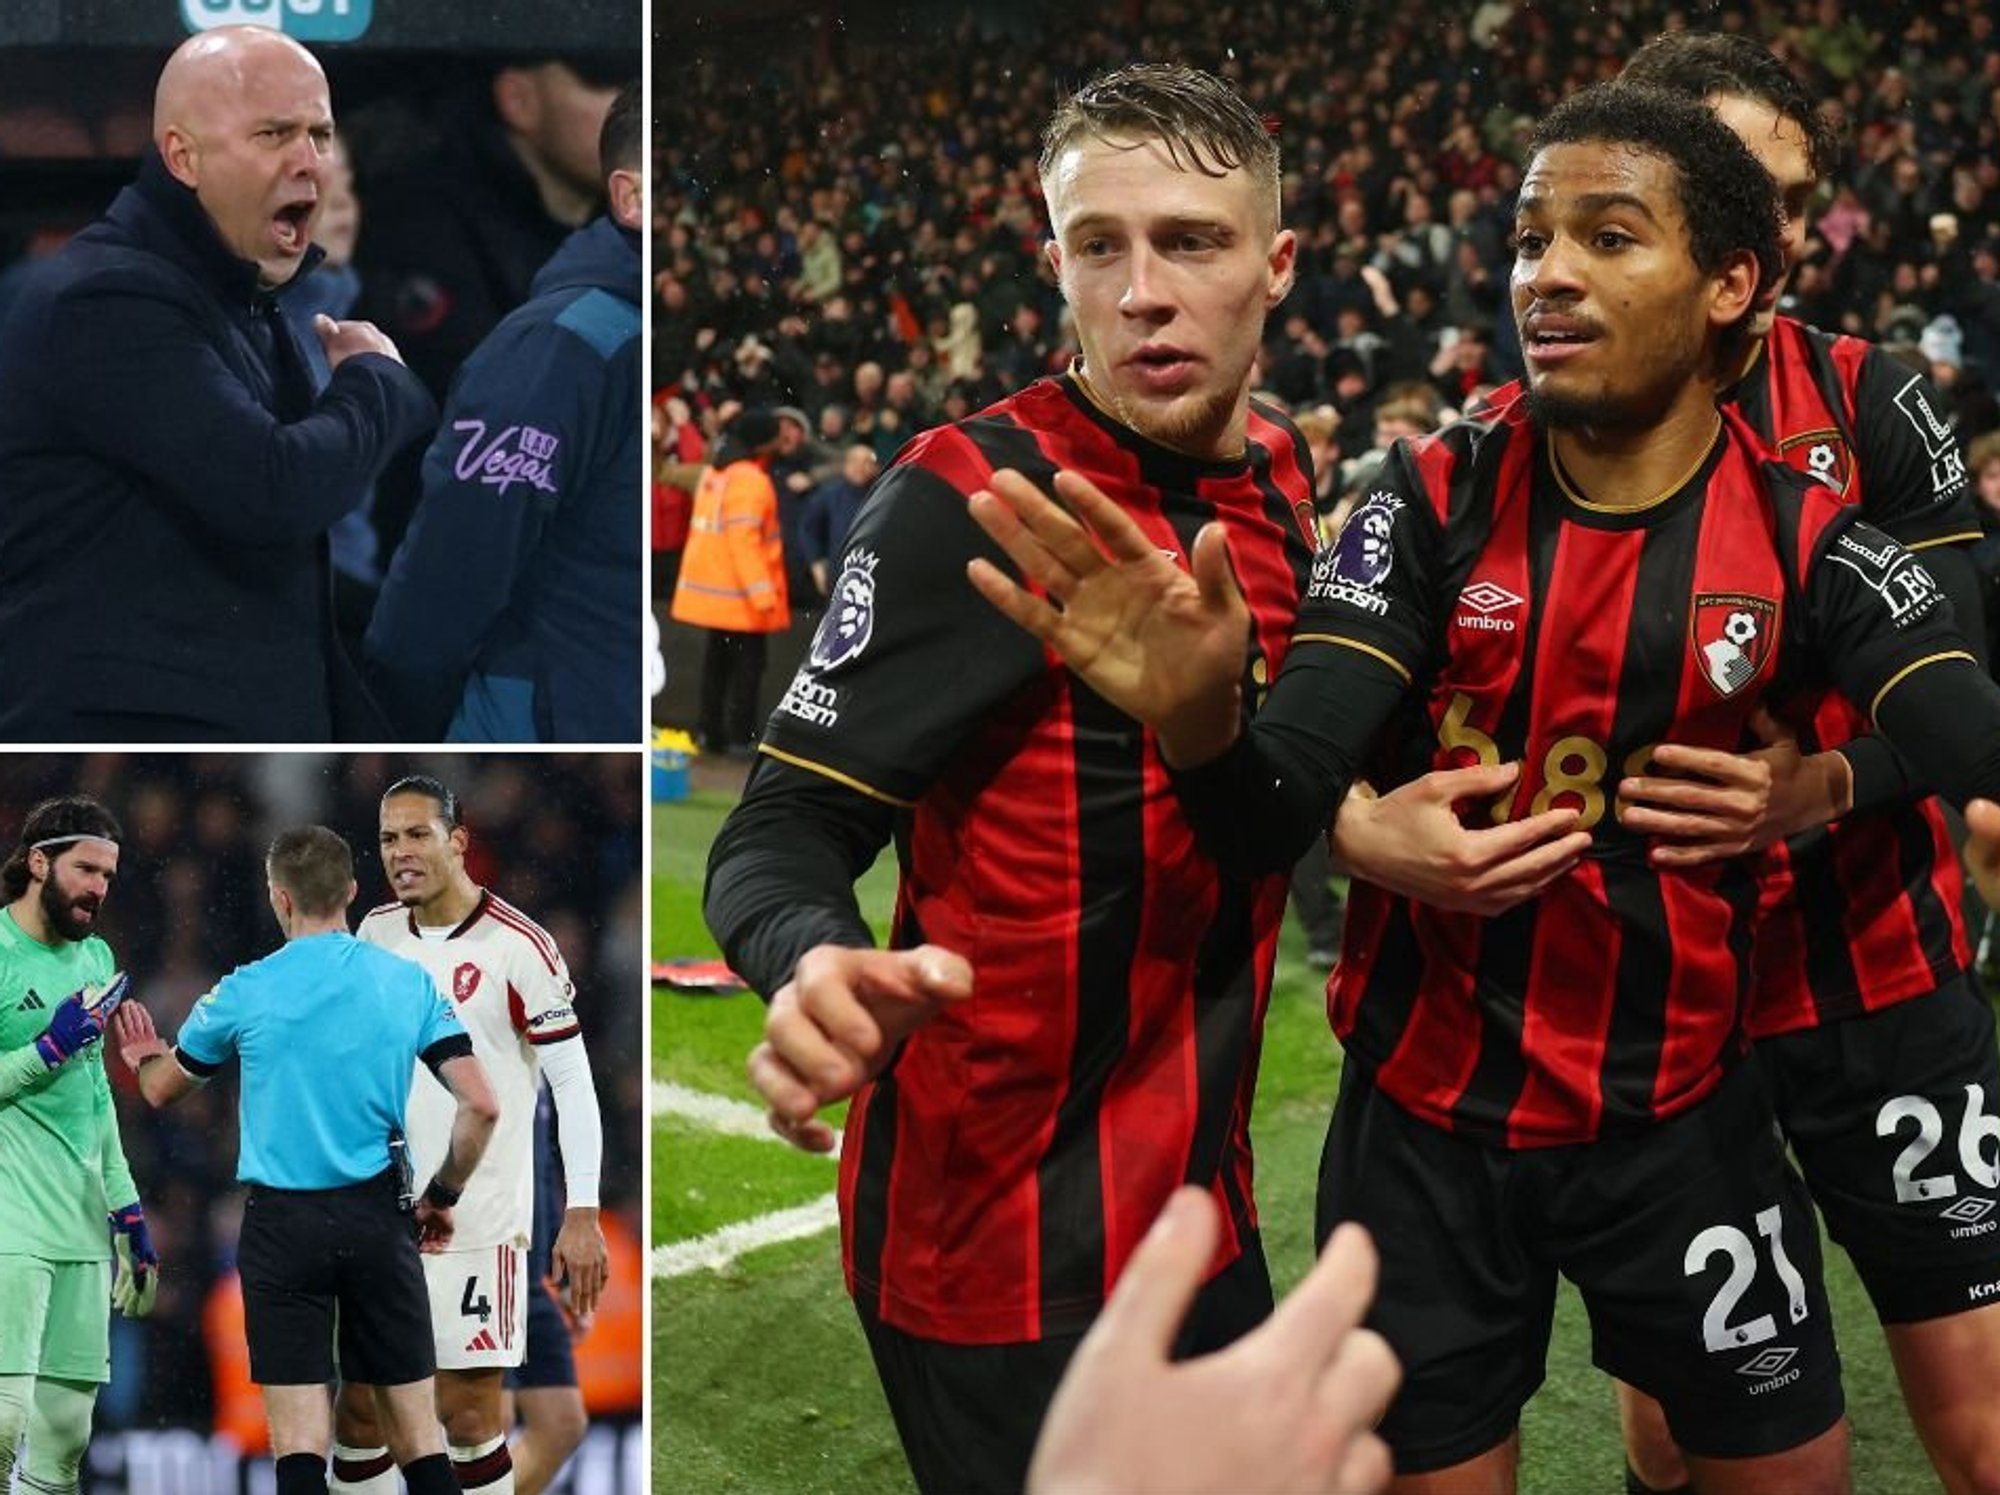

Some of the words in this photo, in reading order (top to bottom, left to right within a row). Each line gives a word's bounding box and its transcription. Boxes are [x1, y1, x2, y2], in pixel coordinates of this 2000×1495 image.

[454, 420, 558, 495] Vegas
[521, 428, 557, 459] LAS
[1322, 583, 1389, 616] racism
[1881, 564, 1936, 619] LEO
[1458, 615, 1515, 631] umbro
[1876, 1083, 2000, 1203] 26
[1950, 1220, 1997, 1239] umbro
[1684, 1204, 1808, 1352] 21
[461, 1276, 492, 1323] 4
[1749, 1368, 1800, 1395] umbro
